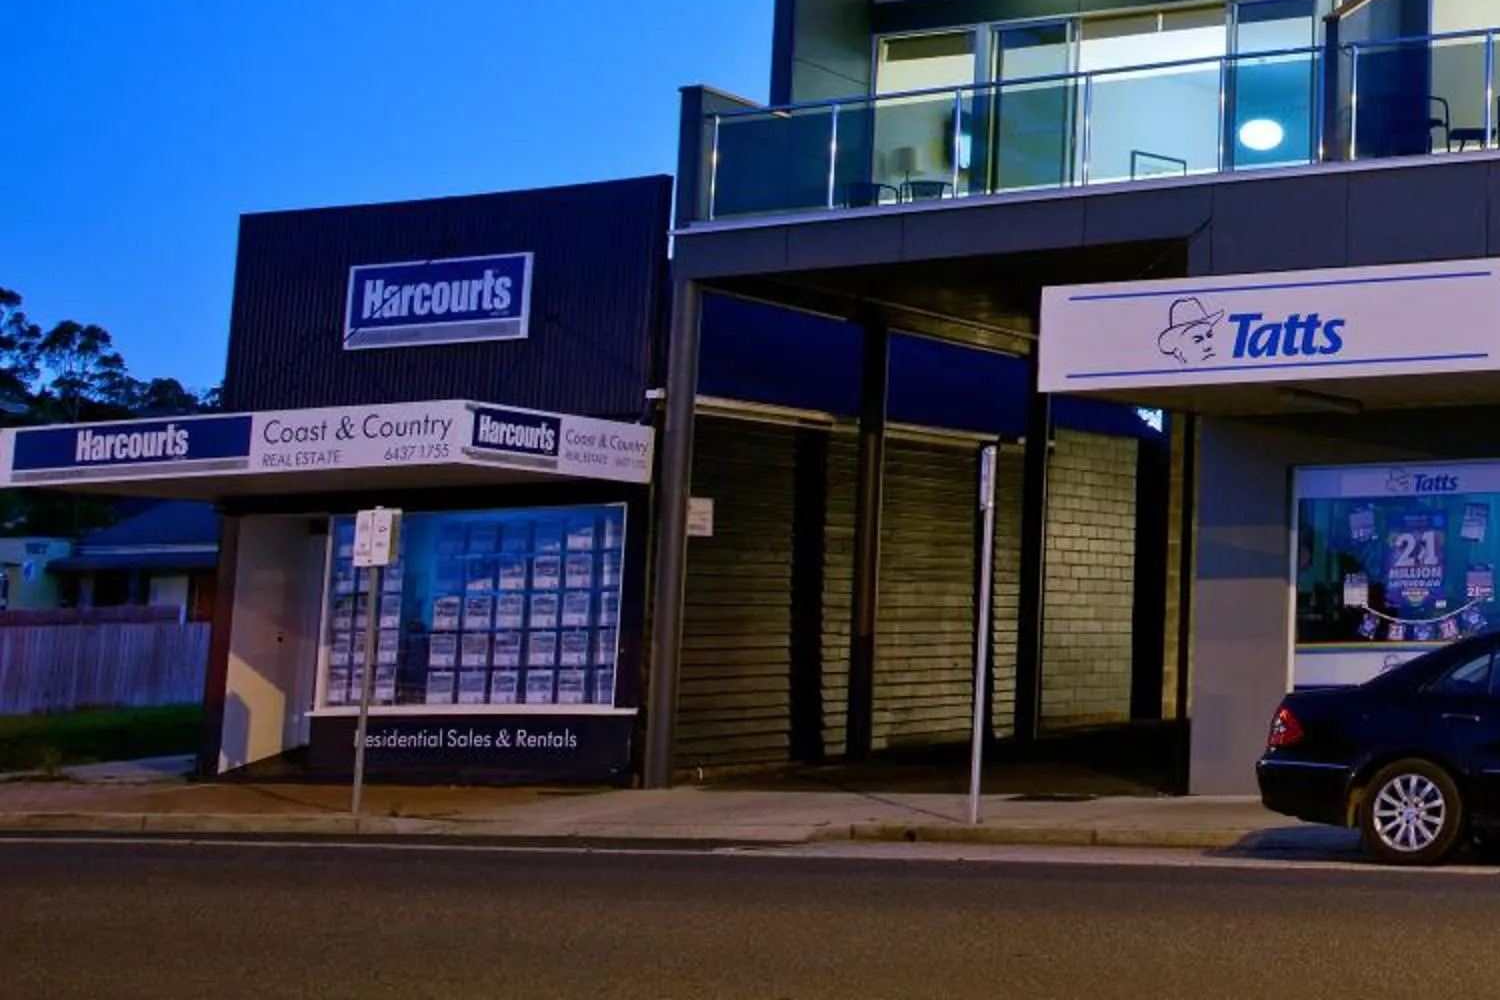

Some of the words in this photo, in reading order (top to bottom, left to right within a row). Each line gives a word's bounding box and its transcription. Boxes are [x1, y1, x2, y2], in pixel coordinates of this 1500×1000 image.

[362, 269, 512, 320] Harcourts
[1228, 312, 1346, 359] Tatts
[75, 424, 189, 461] Harcourts
[263, 419, 328, 444] Coast
[335, 415, 355, 440] &
[363, 414, 453, 440] Country
[478, 414, 556, 451] Harcourts
[261, 453, 293, 467] REAL
[295, 450, 343, 466] ESTATE
[1413, 473, 1458, 493] Tatts
[1394, 531, 1439, 567] 21
[447, 728, 491, 748] Sales
[495, 729, 512, 748] &
[515, 728, 577, 748] Rentals
